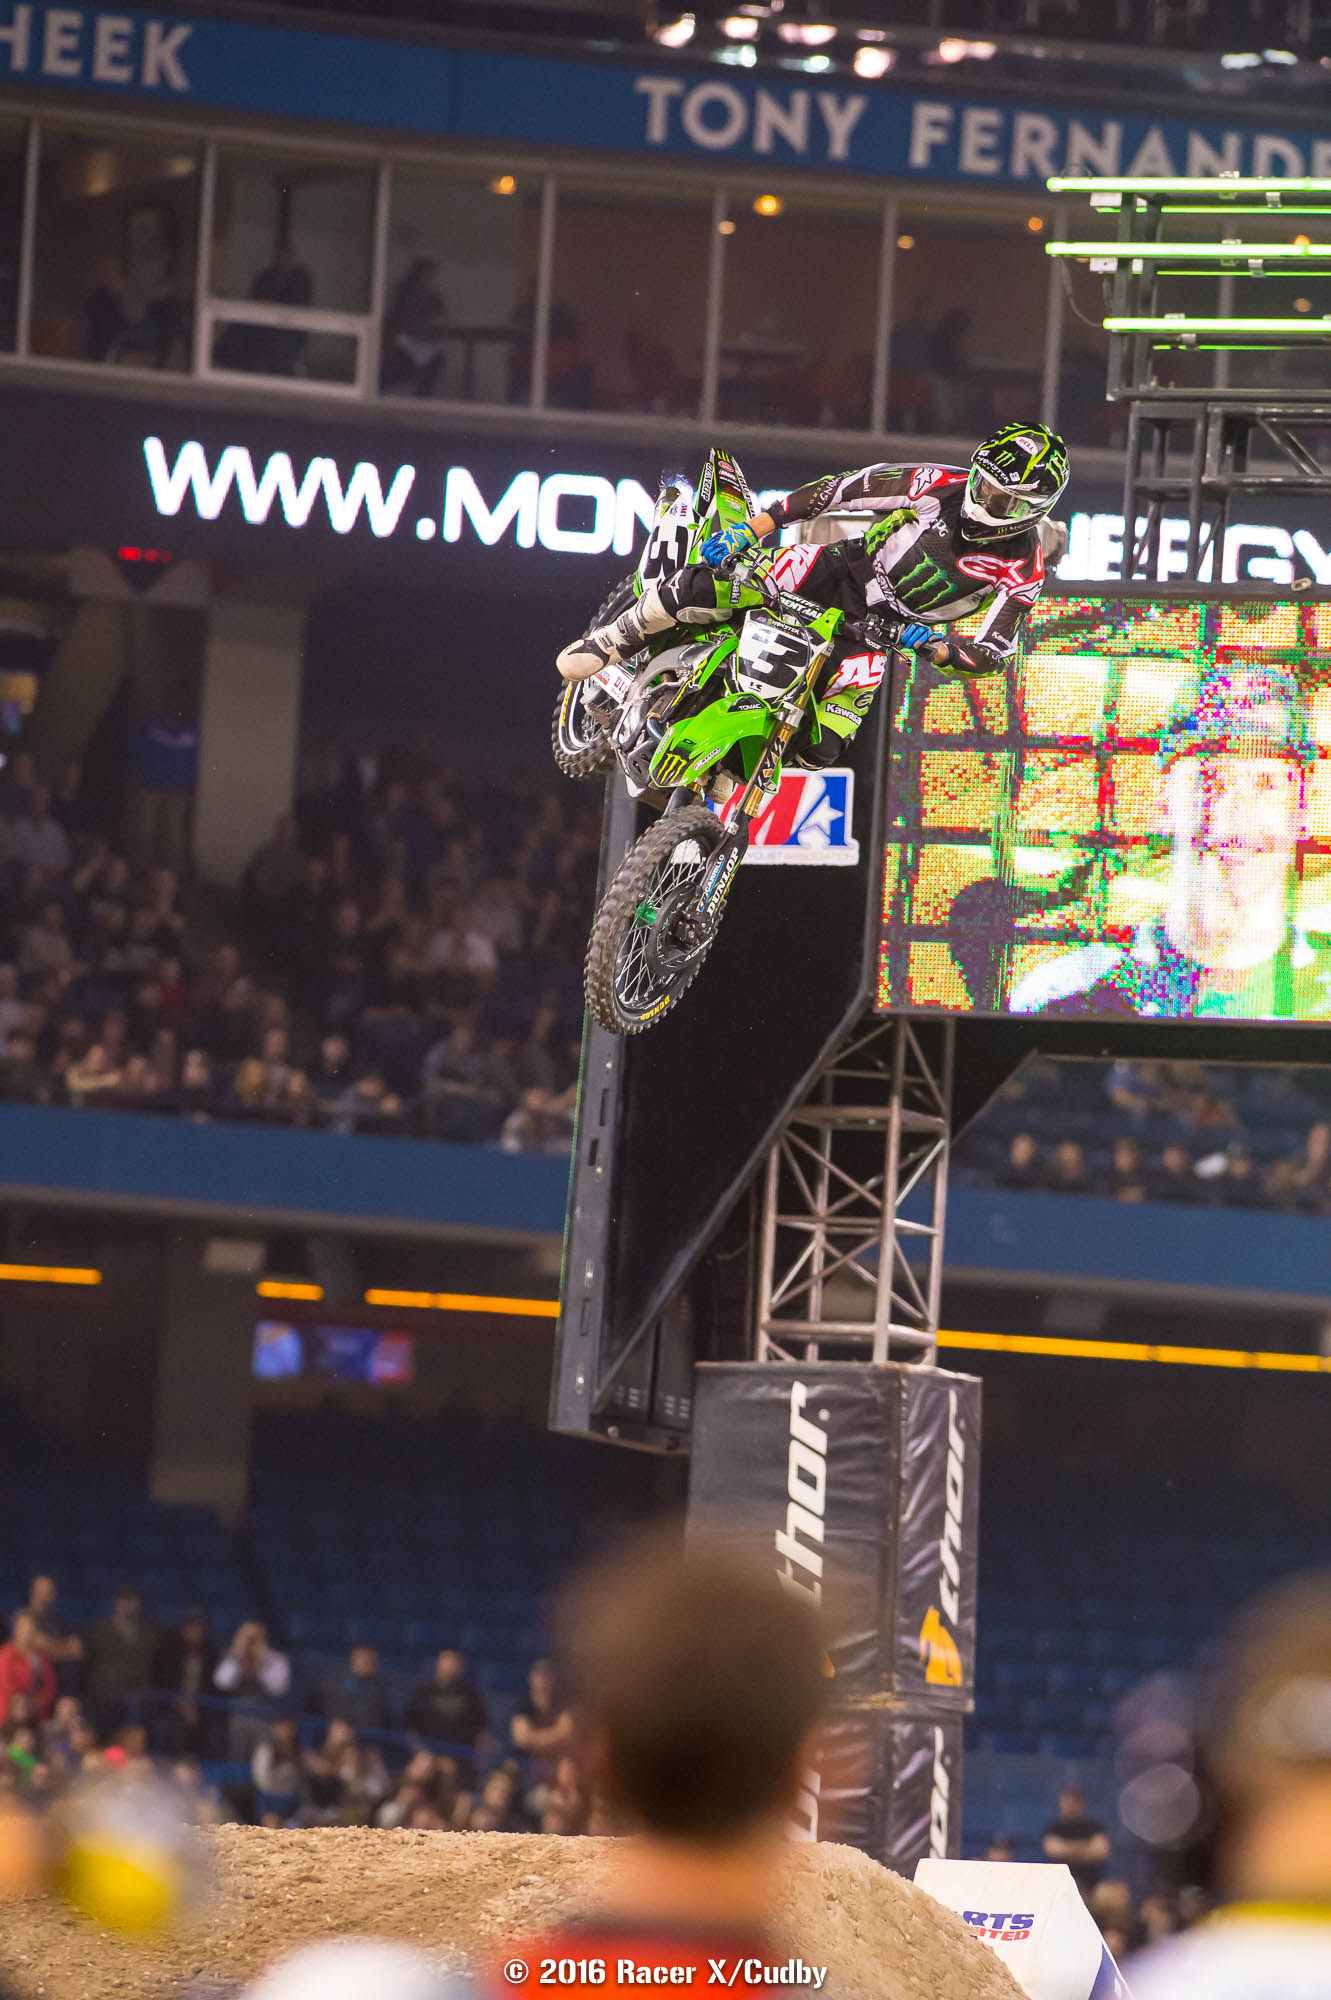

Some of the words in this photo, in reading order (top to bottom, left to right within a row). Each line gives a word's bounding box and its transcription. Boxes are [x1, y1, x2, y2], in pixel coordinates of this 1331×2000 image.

[635, 76, 868, 161] TONY
[976, 456, 1010, 484] MONSTER
[739, 703, 762, 711] TOMAC
[707, 847, 739, 916] DUNLOP
[962, 1910, 1035, 1930] RTS
